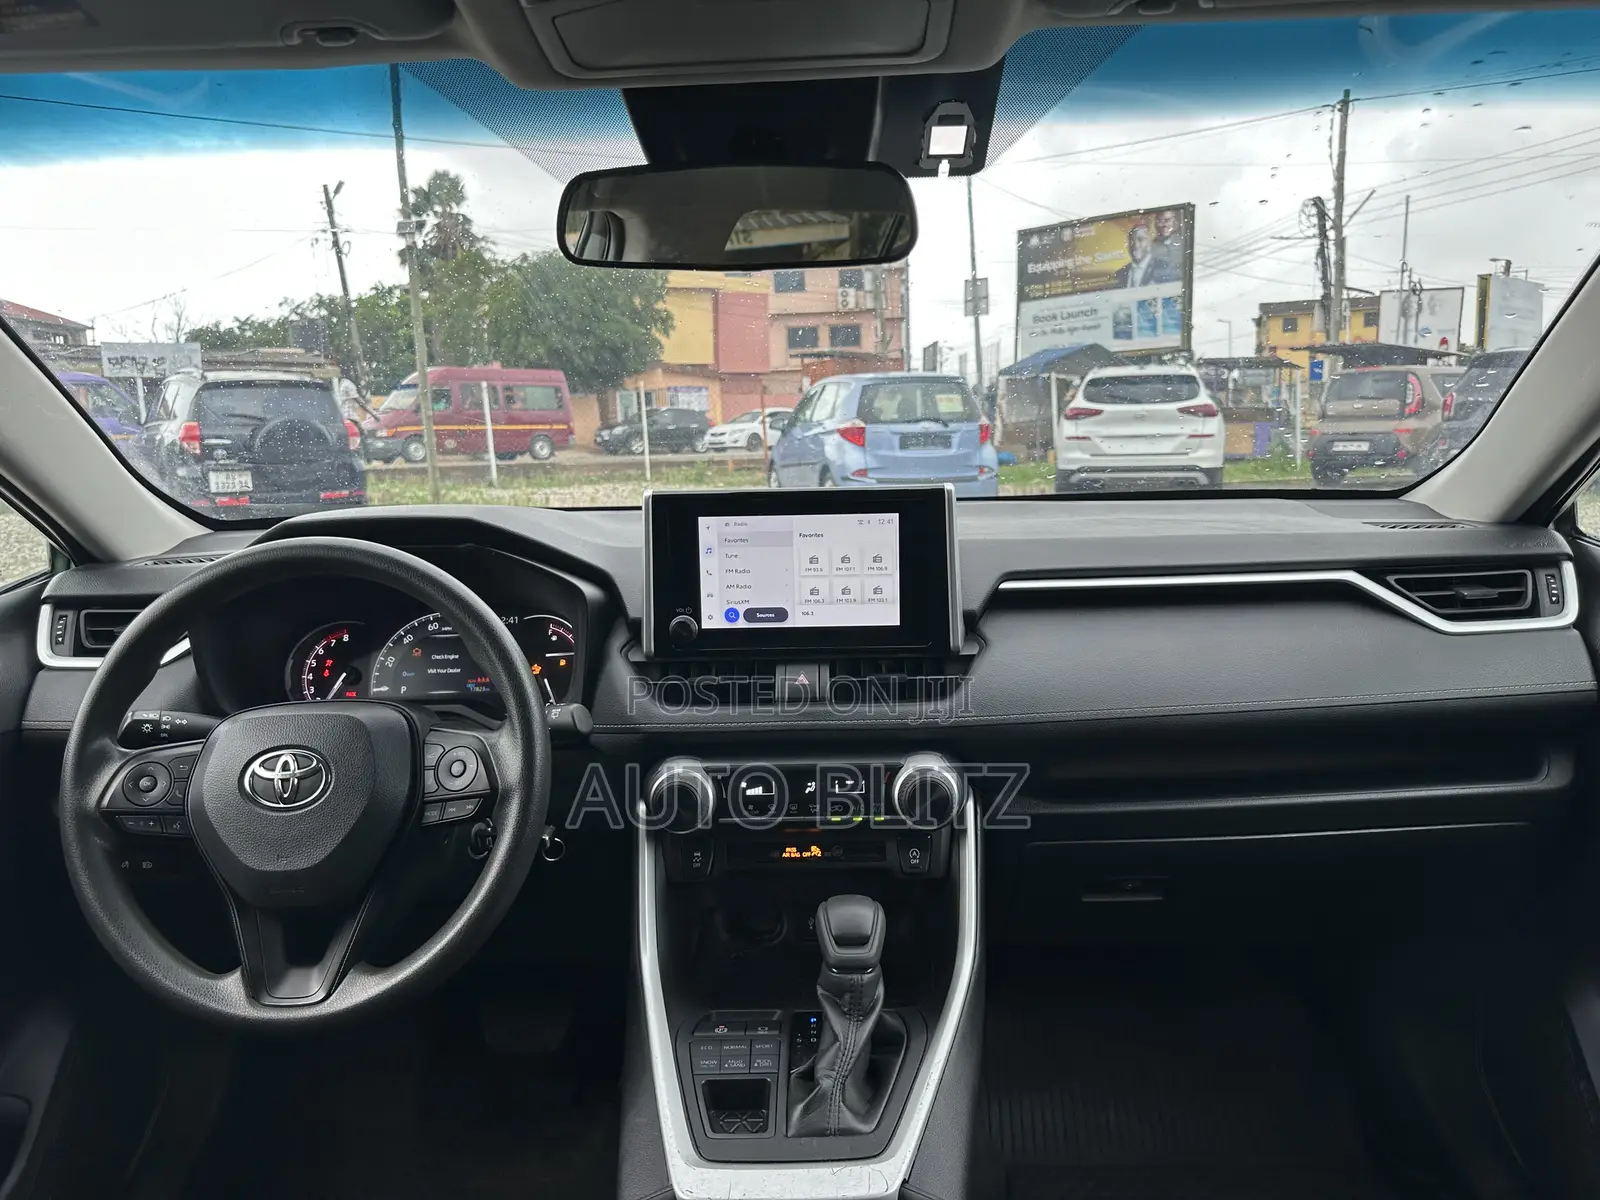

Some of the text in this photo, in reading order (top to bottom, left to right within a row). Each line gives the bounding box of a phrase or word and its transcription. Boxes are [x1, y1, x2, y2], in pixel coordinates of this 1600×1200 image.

[1032, 308, 1098, 324] Book Launch
[428, 622, 439, 631] 60
[403, 634, 414, 644] 40
[385, 656, 396, 667] 20
